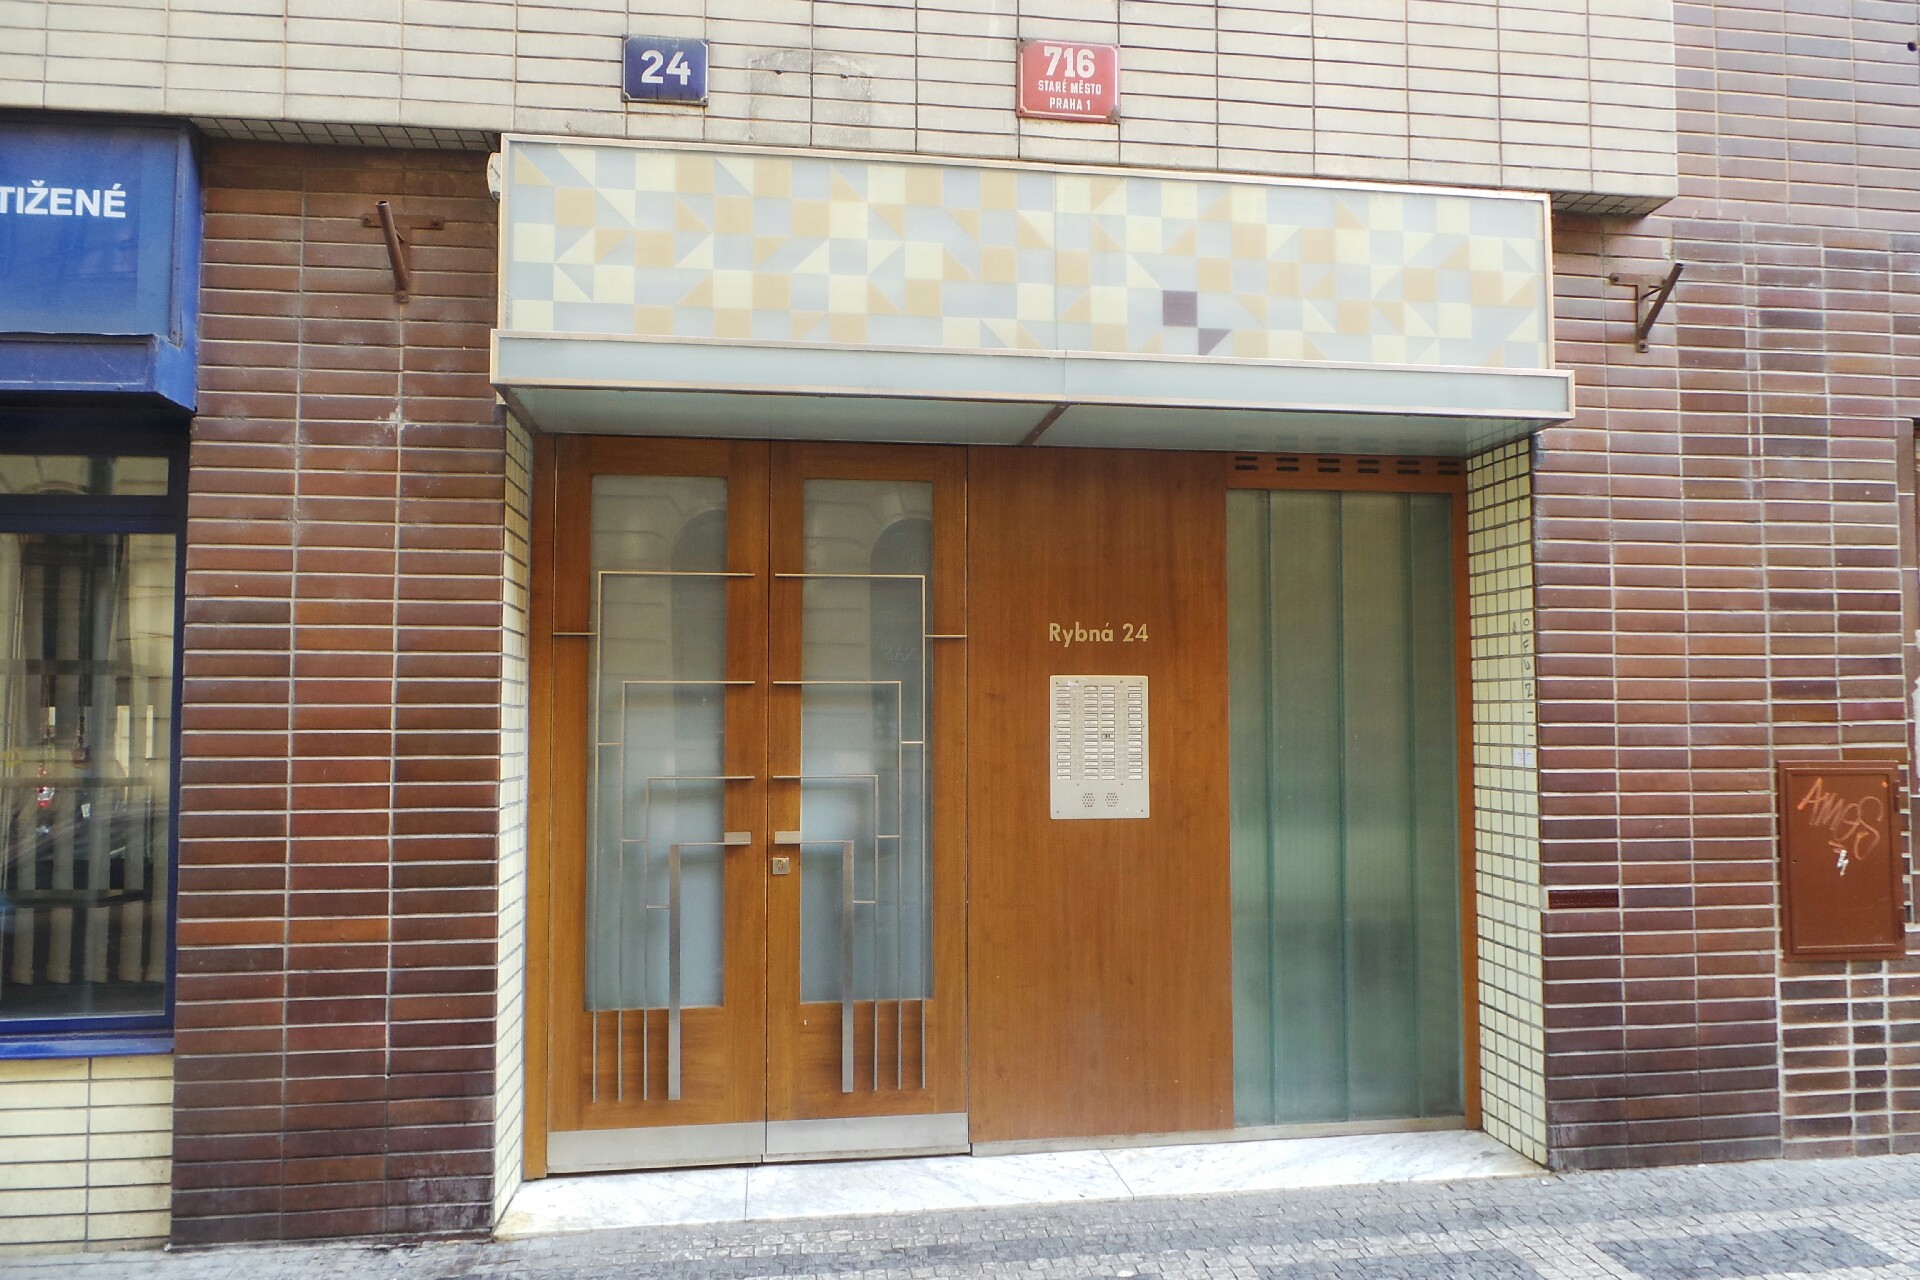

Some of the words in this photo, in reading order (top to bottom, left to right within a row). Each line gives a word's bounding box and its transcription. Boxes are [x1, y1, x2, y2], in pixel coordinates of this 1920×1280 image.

[640, 49, 691, 86] 24
[1043, 46, 1096, 78] 716
[1037, 77, 1068, 93] STARÉ
[1070, 79, 1102, 95] MĚSTO
[1049, 96, 1083, 110] PRAHA
[1085, 99, 1092, 111] 1
[1049, 622, 1114, 647] Rybná
[1122, 623, 1149, 642] 24
